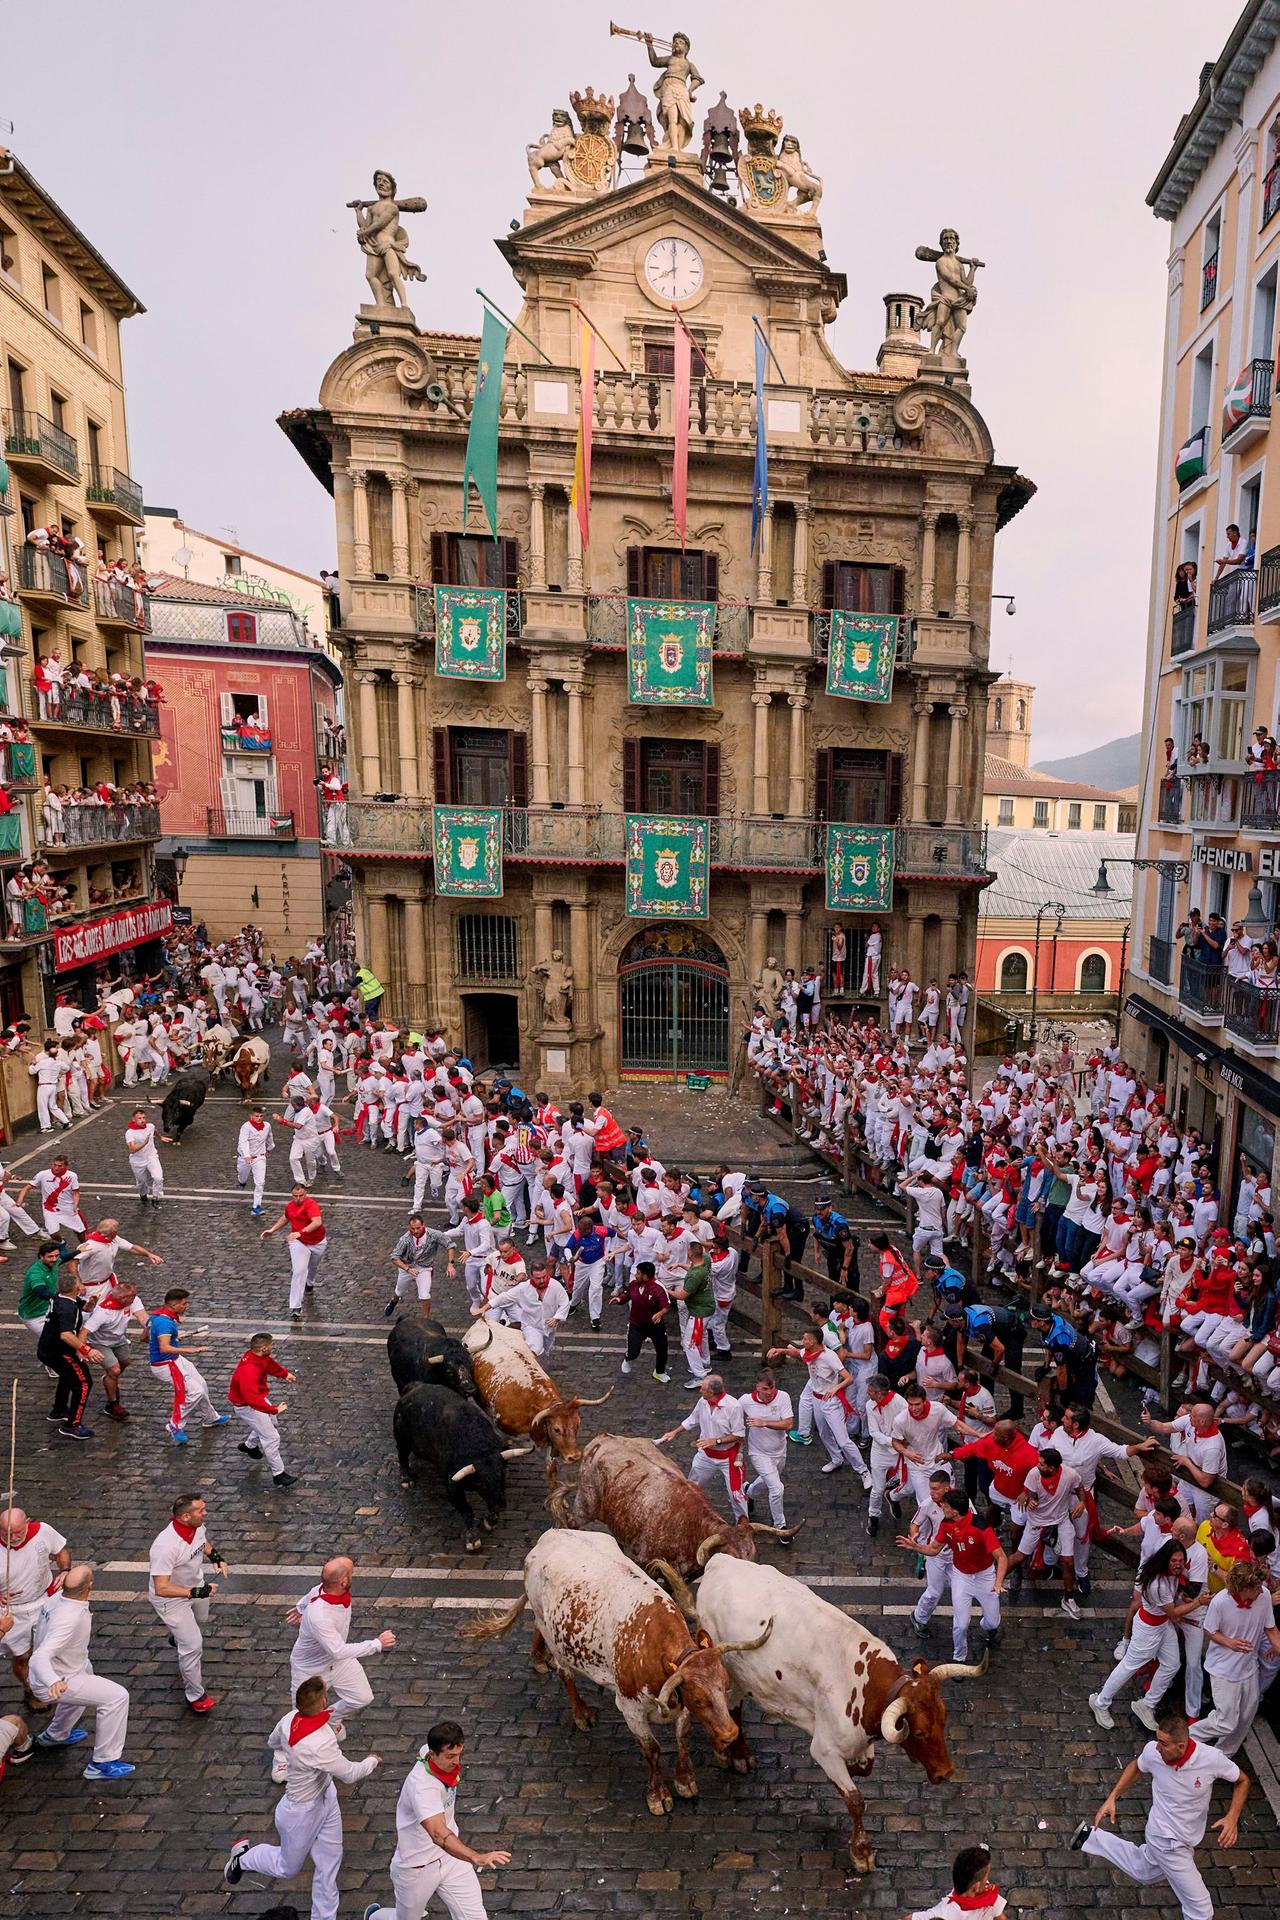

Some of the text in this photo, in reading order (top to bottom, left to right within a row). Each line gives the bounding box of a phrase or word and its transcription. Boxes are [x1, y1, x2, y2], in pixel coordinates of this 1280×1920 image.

[1192, 845, 1247, 872] AGENCIA
[281, 863, 291, 934] FARMACIA
[58, 935, 73, 963] LOS
[73, 926, 103, 958] MEJORES
[136, 913, 144, 937] DE
[144, 904, 172, 934] PAMPLONA
[1220, 1064, 1232, 1081] BAR
[957, 1542, 966, 1552] 10
